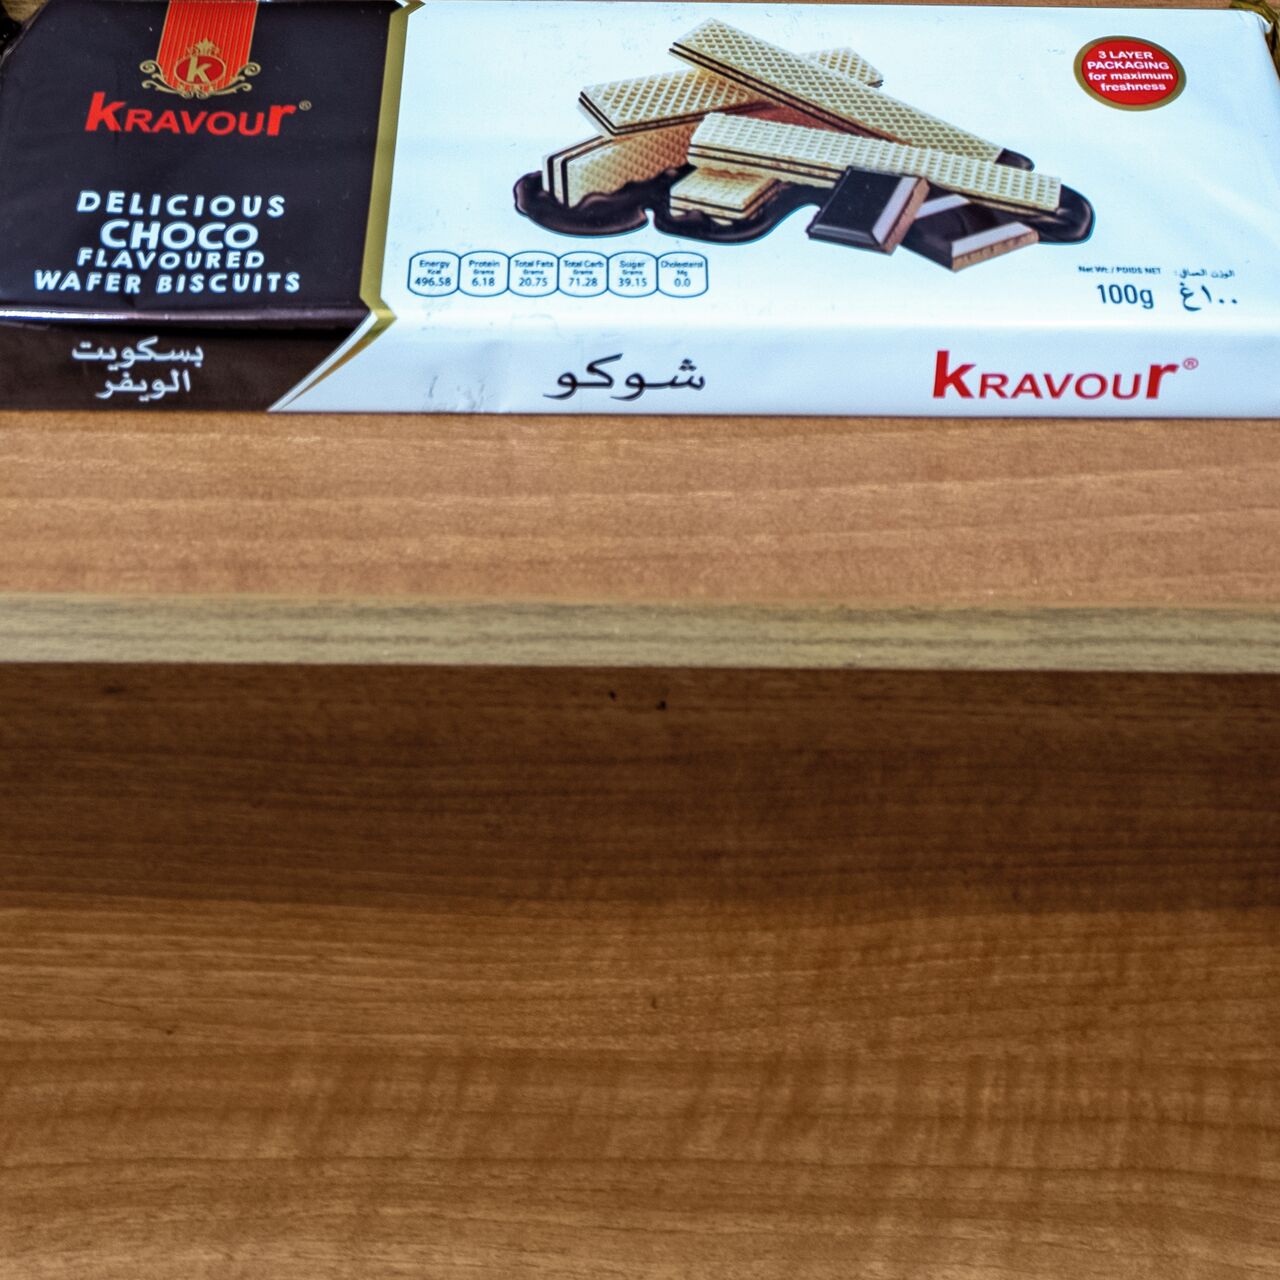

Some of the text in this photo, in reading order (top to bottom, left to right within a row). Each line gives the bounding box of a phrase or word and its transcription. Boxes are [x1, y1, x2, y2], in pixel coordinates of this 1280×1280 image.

[1098, 50, 1154, 59] 3 LAYER
[1087, 61, 1169, 70] PACKAGING
[1088, 71, 1173, 81] for maximum
[1100, 82, 1167, 92] freshness
[76, 190, 286, 218] DELICIOUS
[99, 220, 259, 251] CHOCO
[76, 248, 265, 270] FLAVOURED
[468, 260, 500, 268] Protein
[419, 260, 451, 269] Energy
[619, 260, 646, 269] Sugar
[33, 271, 301, 294] WAFER BISCUITS
[414, 277, 452, 287] 496.58
[471, 277, 496, 287] 6.18
[518, 277, 548, 287] 20.75
[568, 277, 598, 287] 71.28
[618, 277, 648, 287] 39.15
[673, 278, 691, 287] 0.0
[1096, 284, 1155, 310] 100g
[71, 336, 205, 368] بسكويت
[542, 352, 706, 402] شوكو
[95, 370, 192, 403] الويفر
